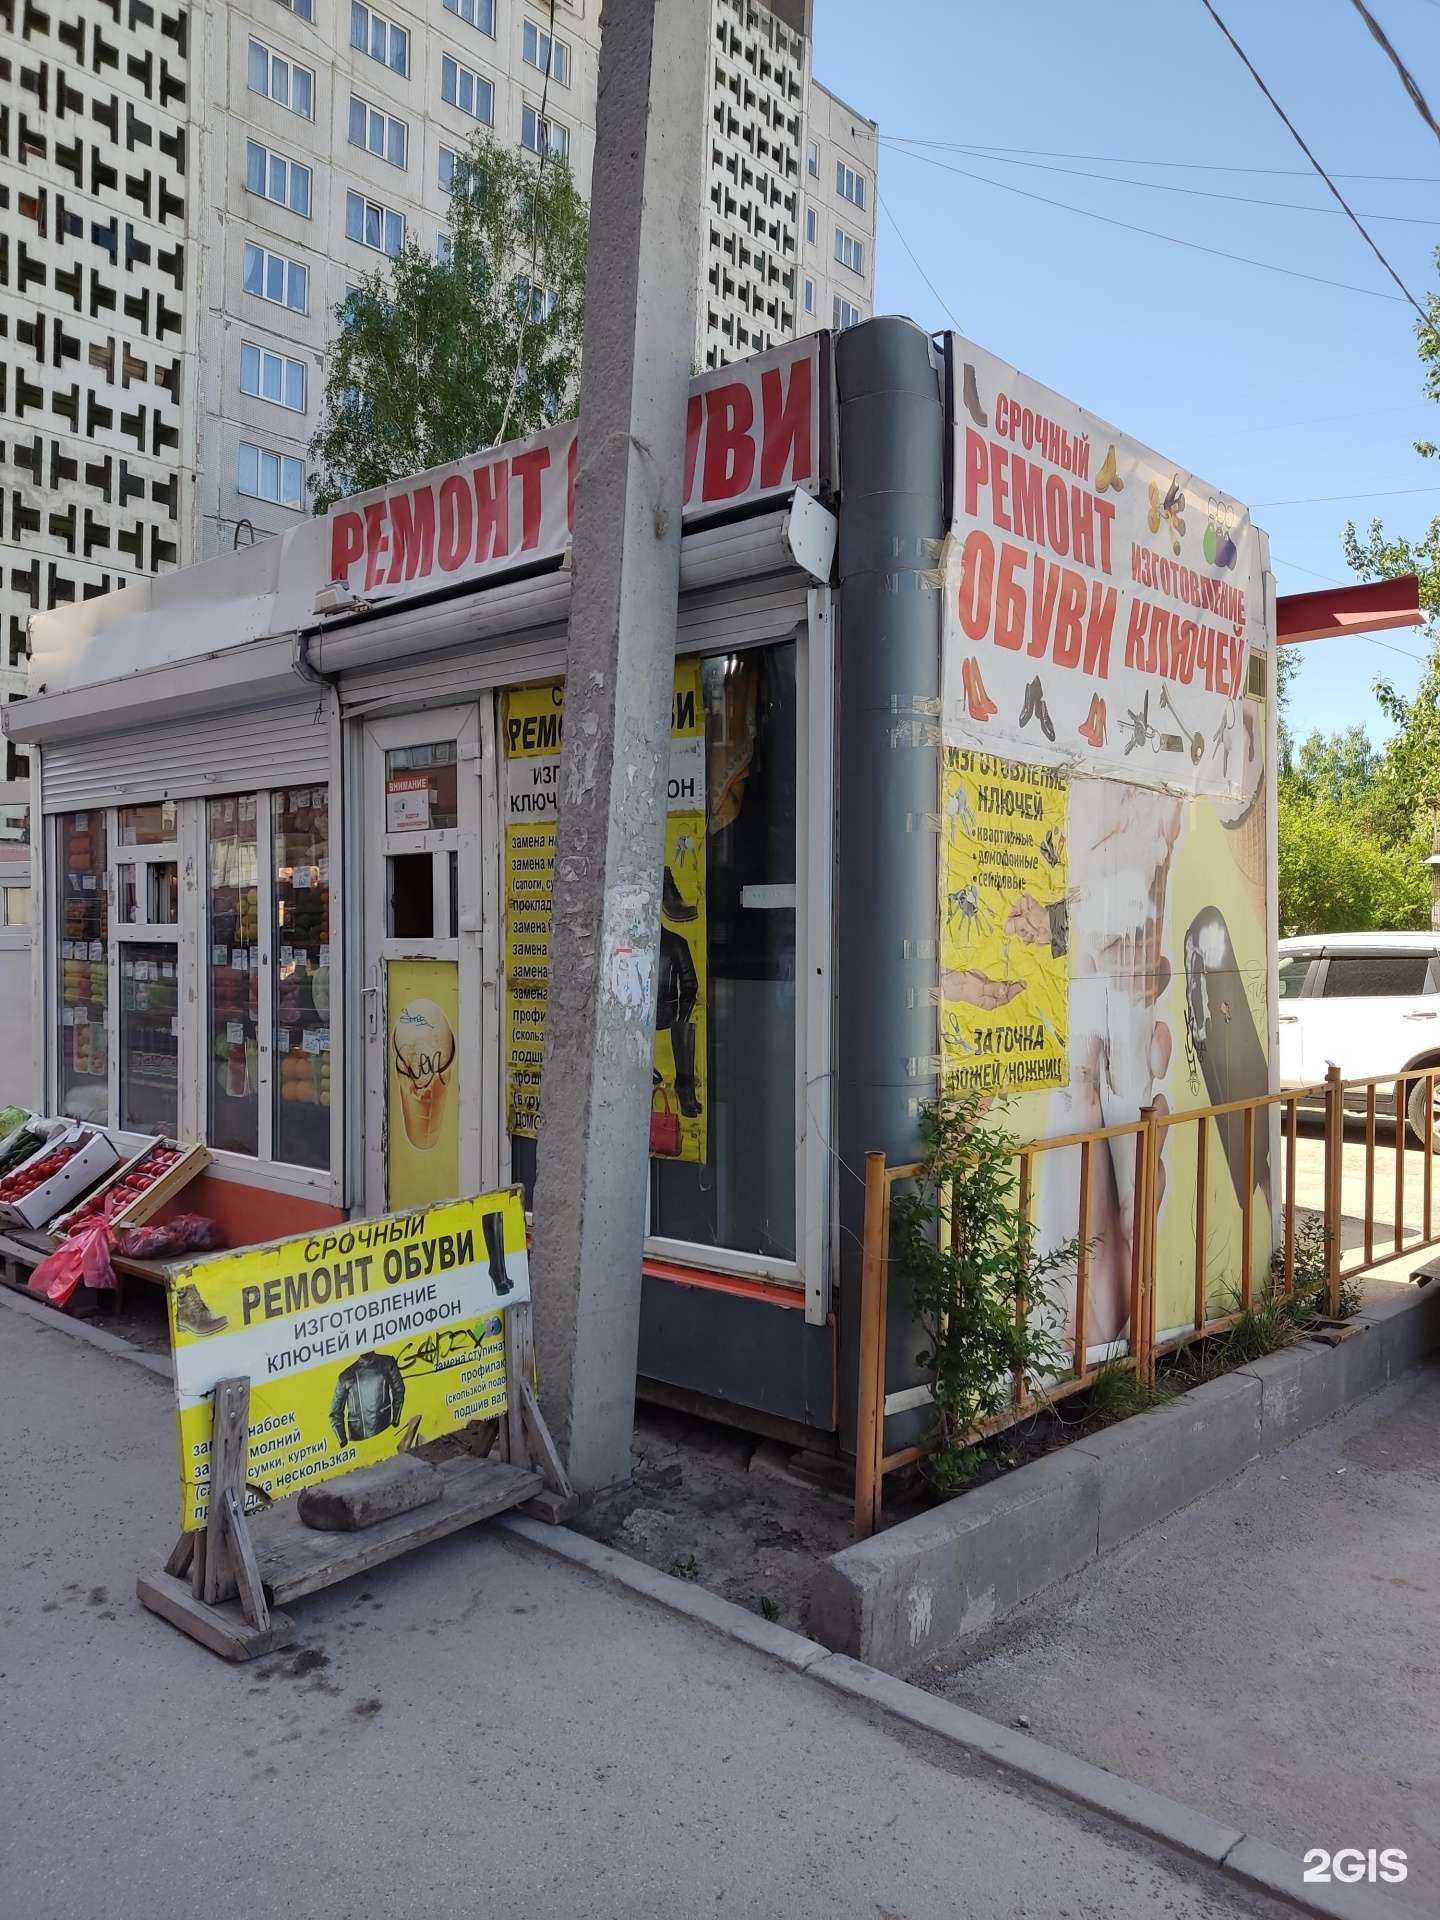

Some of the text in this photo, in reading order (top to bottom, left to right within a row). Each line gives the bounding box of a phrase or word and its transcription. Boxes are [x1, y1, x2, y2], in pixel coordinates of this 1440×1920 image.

[995, 392, 1090, 481] СРОЧНЫЙ
[965, 426, 1116, 575] РЕМОНТ
[331, 447, 551, 592] РЕМОНТ
[1131, 542, 1246, 625] ИЗГОТОВЛЕНИЕ
[958, 530, 1118, 680] ОБУВИ
[1124, 598, 1246, 700] КЛЮЧЕЙ
[508, 714, 563, 751] РЕМ
[389, 778, 428, 791] ВНИМАНИЕ
[510, 792, 558, 812] КЛЮЧ
[977, 785, 1043, 821] КЛЮЧЕЙ
[512, 836, 545, 848] замена
[512, 858, 545, 870] замена
[513, 899, 552, 914] проклад
[513, 921, 546, 933] замена
[512, 943, 547, 955] замена
[513, 966, 548, 978] замена
[512, 1028, 544, 1042] (скольз
[242, 1230, 475, 1325] РЕМОНТ ОБУВИ
[294, 1284, 437, 1340] ИЗГОТОВЛЕНИЕ
[267, 1329, 350, 1373] КЛЮЧЕЙ
[355, 1327, 367, 1346] И
[373, 1300, 462, 1343] ДОМОФОН
[461, 1359, 506, 1383] профилак
[248, 1412, 296, 1438] набоек
[454, 1398, 489, 1419] подшив
[248, 1438, 328, 1478] сумки, куртки)
[250, 1428, 301, 1458] молний
[276, 1448, 356, 1487] нескользкая
